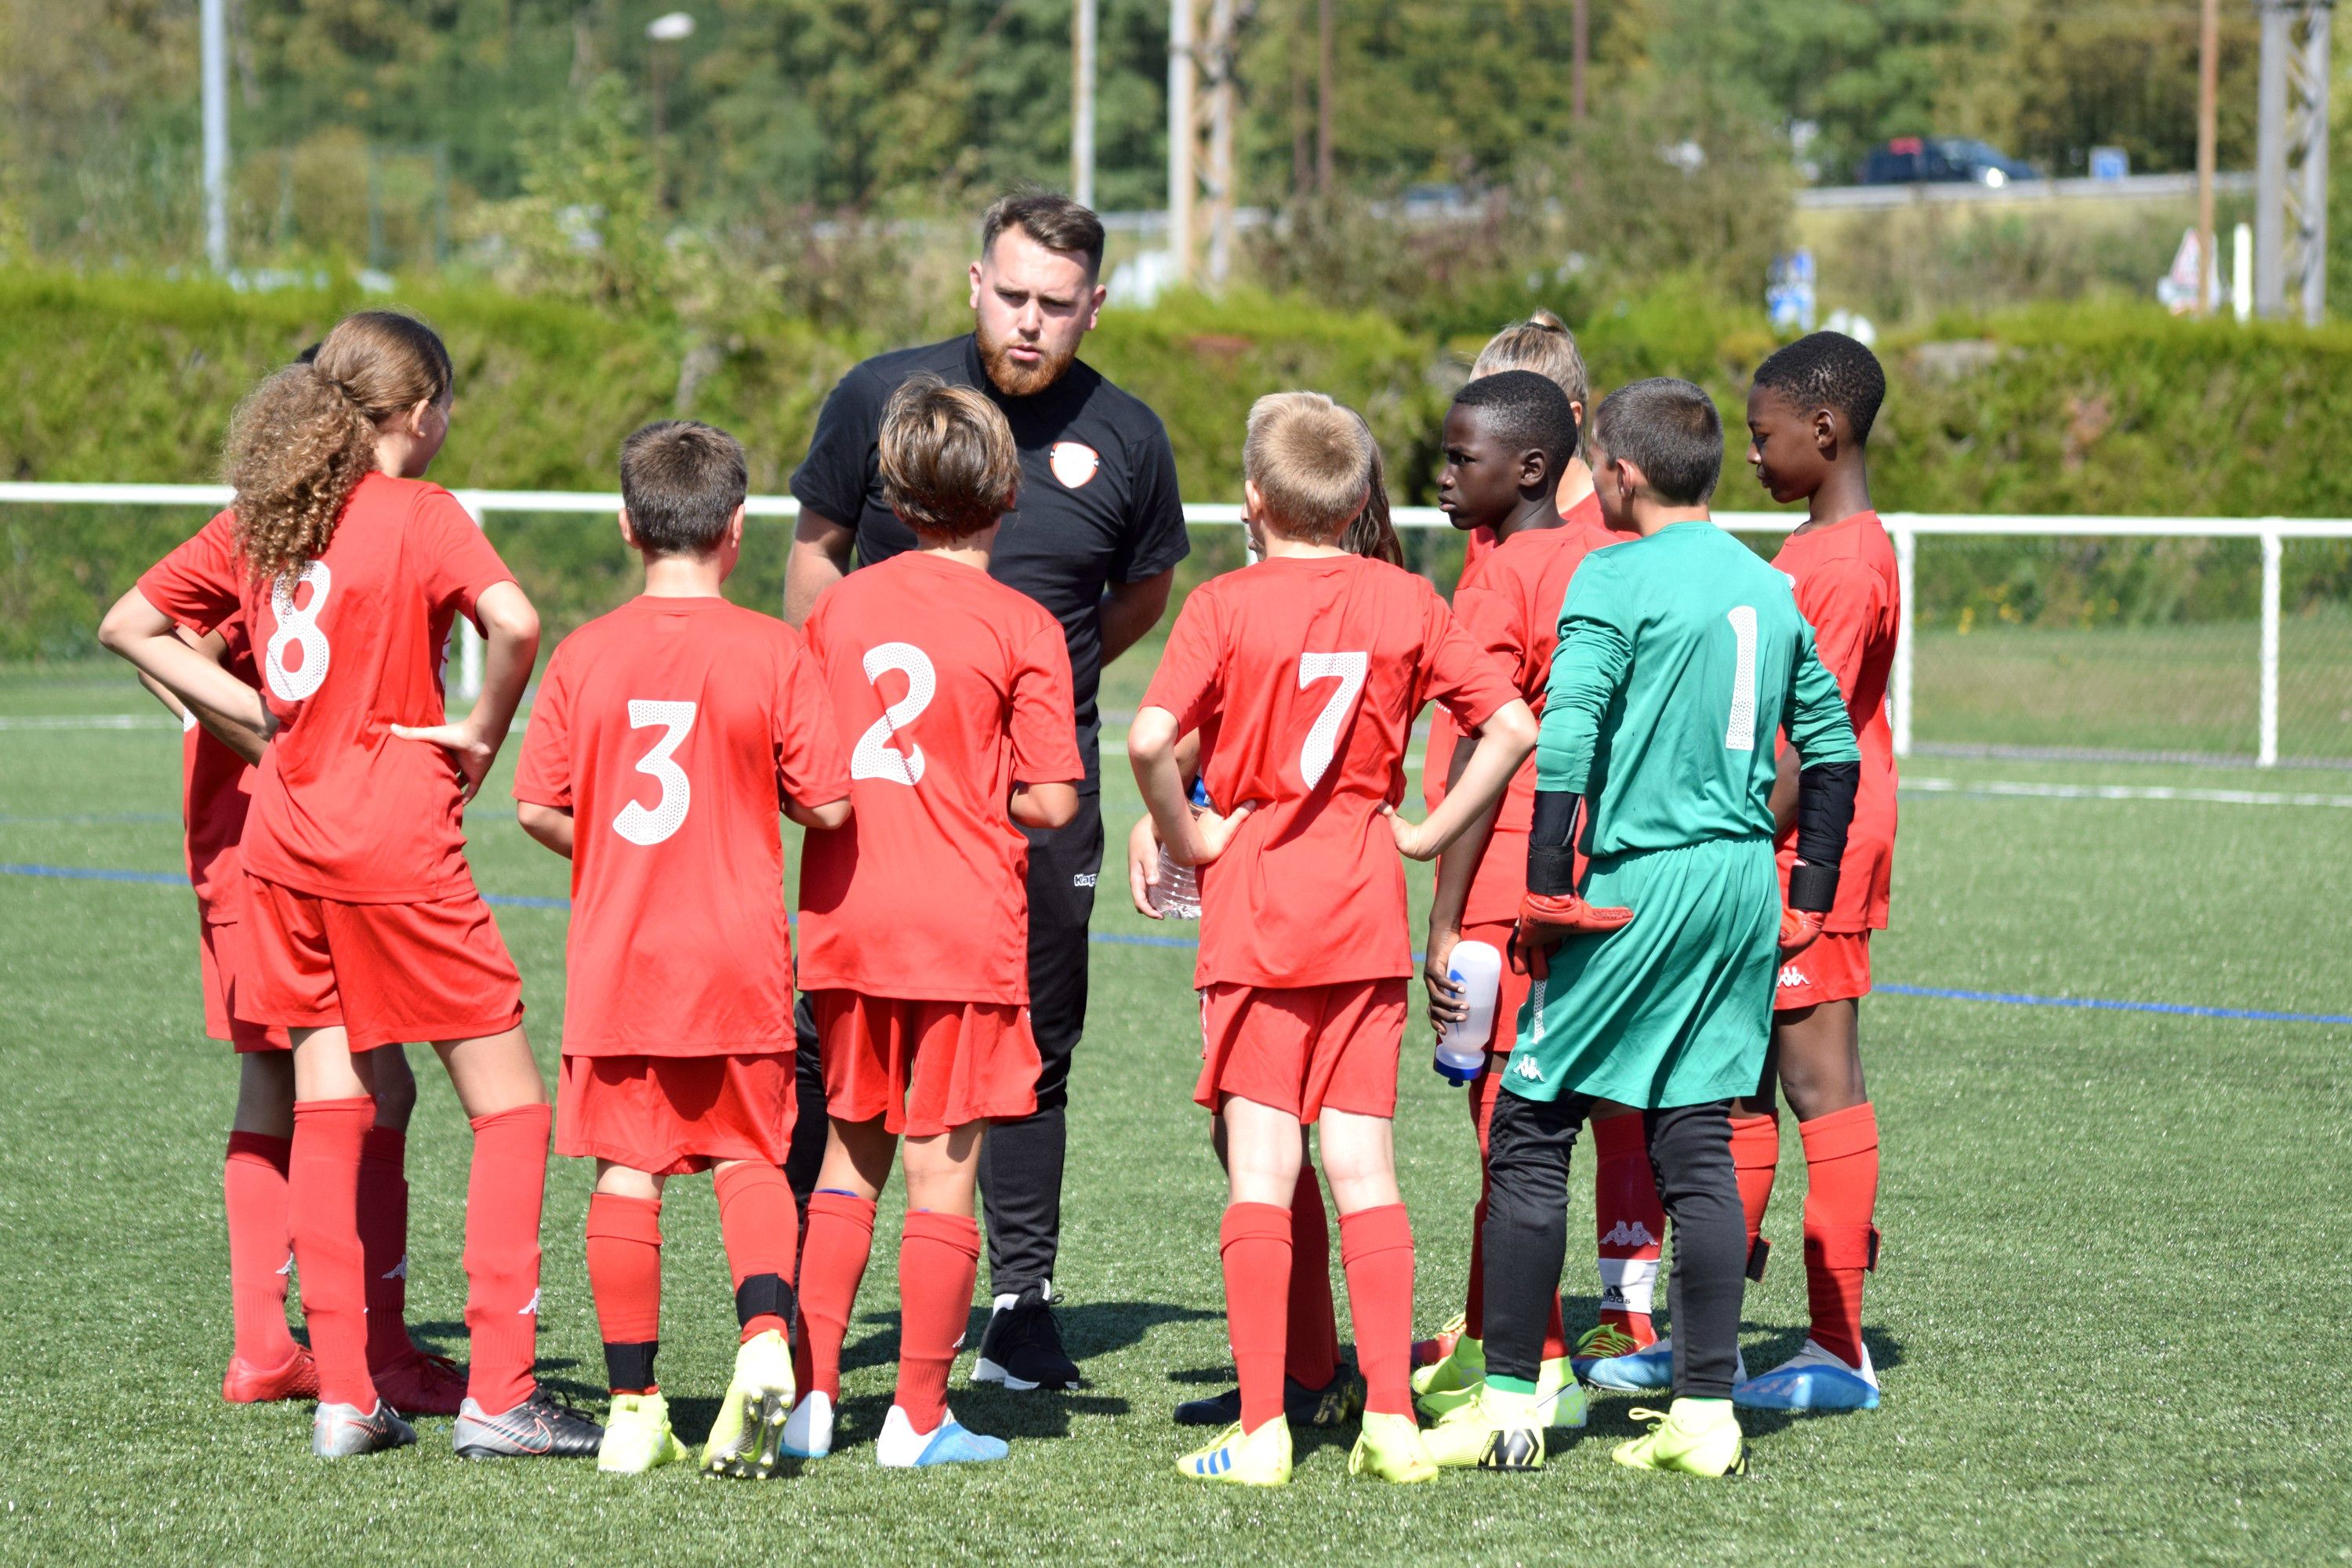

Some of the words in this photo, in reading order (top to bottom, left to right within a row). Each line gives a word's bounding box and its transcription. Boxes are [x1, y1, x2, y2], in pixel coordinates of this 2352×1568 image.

[265, 560, 332, 702] 8
[1726, 605, 1758, 752] 1
[612, 699, 697, 846] 3
[851, 642, 937, 786] 2
[1299, 651, 1369, 791] 7
